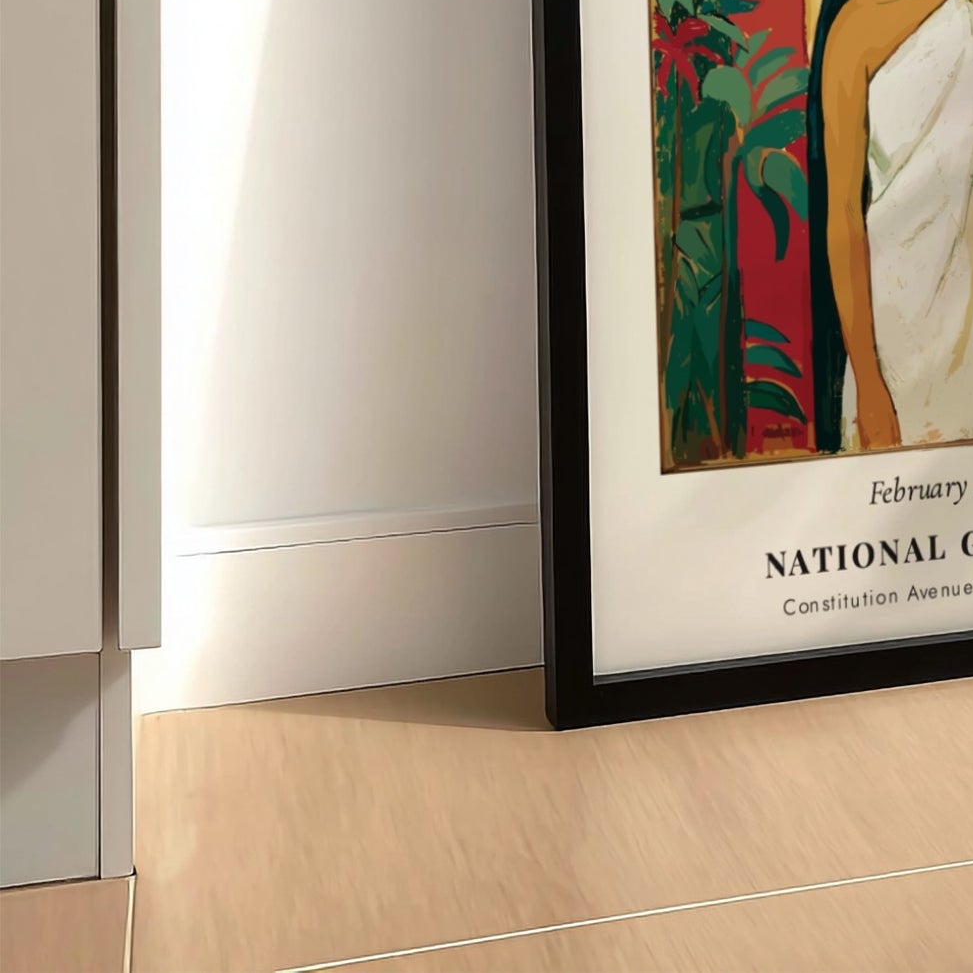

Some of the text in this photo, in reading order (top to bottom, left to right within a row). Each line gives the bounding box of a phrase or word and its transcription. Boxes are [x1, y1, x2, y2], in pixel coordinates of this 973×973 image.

[869, 475, 968, 506] February
[764, 534, 946, 580] NATIONAL
[782, 589, 898, 617] Constitution
[906, 582, 973, 602] Avenue
